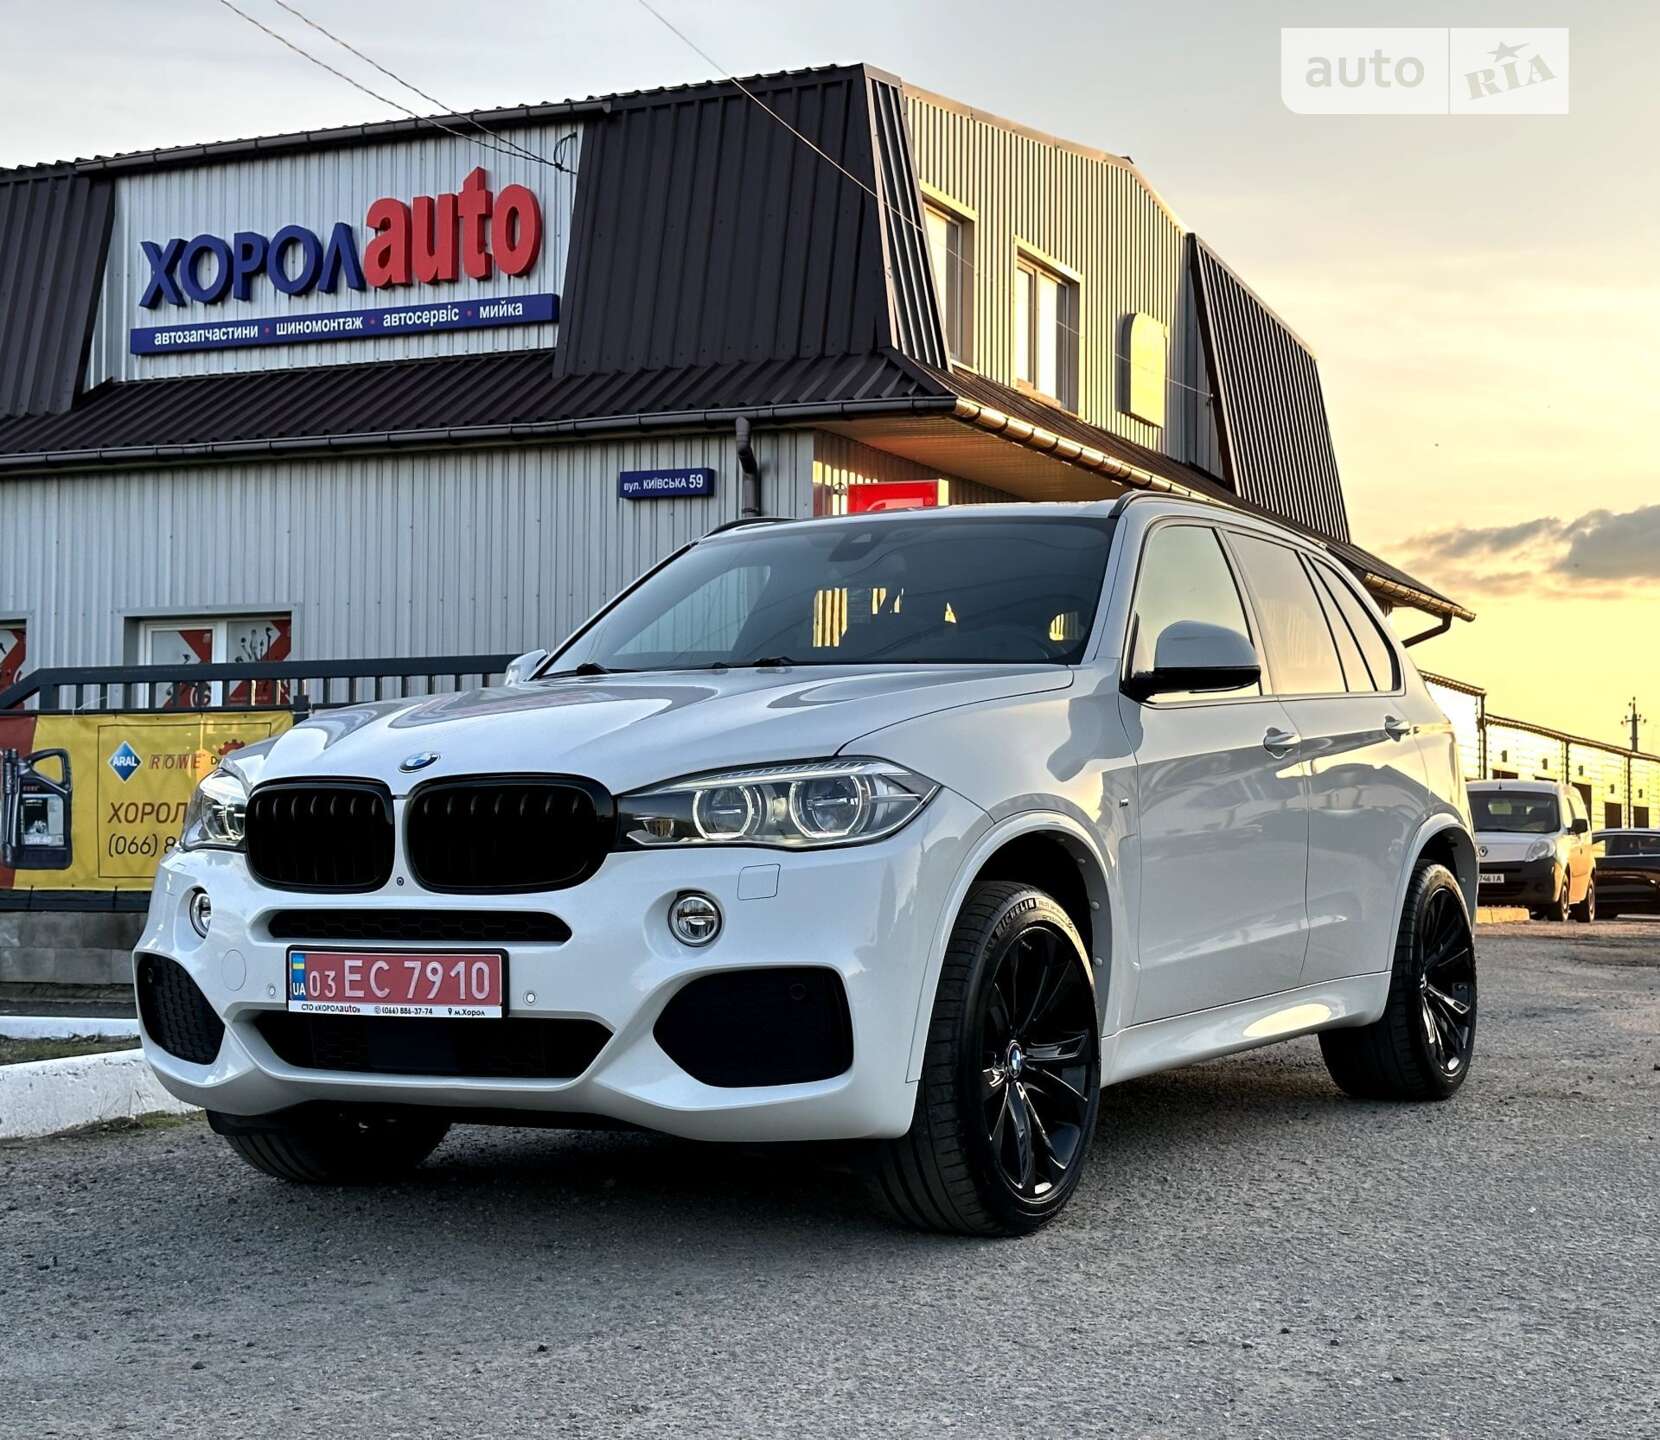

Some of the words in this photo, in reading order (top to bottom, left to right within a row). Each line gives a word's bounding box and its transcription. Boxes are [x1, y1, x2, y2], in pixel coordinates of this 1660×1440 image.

[154, 323, 259, 346] автозапчастини
[275, 314, 363, 336] шиномонтаж
[382, 305, 460, 328] автосервіс
[479, 302, 524, 320] мийка
[623, 481, 641, 493] вул.
[643, 477, 687, 490] КИЇВСЬКА
[688, 473, 704, 488] 59
[112, 756, 138, 767] ARAL
[149, 753, 202, 769] ROWE
[107, 802, 188, 824] ХОРОЛ
[108, 833, 158, 857] (066)
[996, 897, 1037, 938] MICHELIN
[292, 982, 306, 996] UA
[309, 970, 337, 998] 03
[403, 960, 490, 1000] 7910
